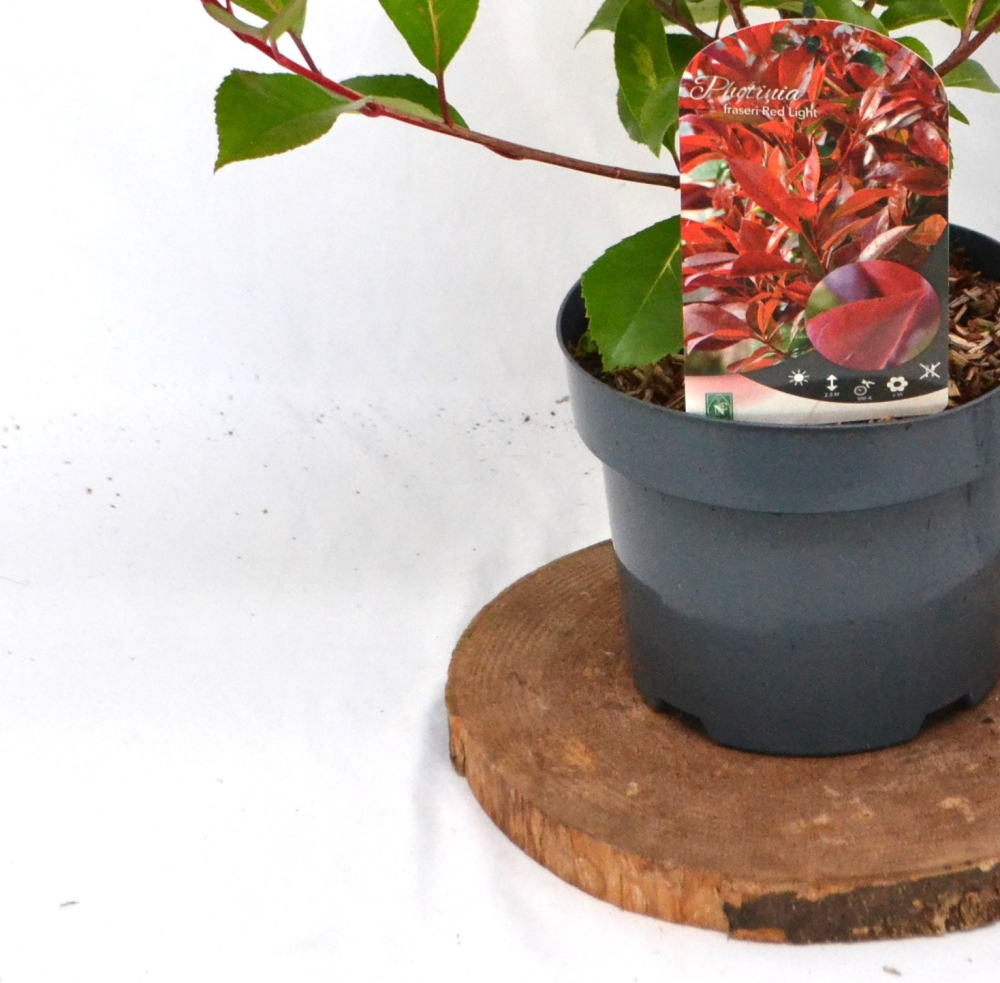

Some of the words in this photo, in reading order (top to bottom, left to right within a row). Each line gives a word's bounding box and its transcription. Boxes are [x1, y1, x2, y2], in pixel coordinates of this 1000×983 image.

[690, 75, 800, 104] Photinia
[723, 103, 759, 116] fraseri
[762, 105, 785, 117] Red
[788, 105, 818, 120] Light
